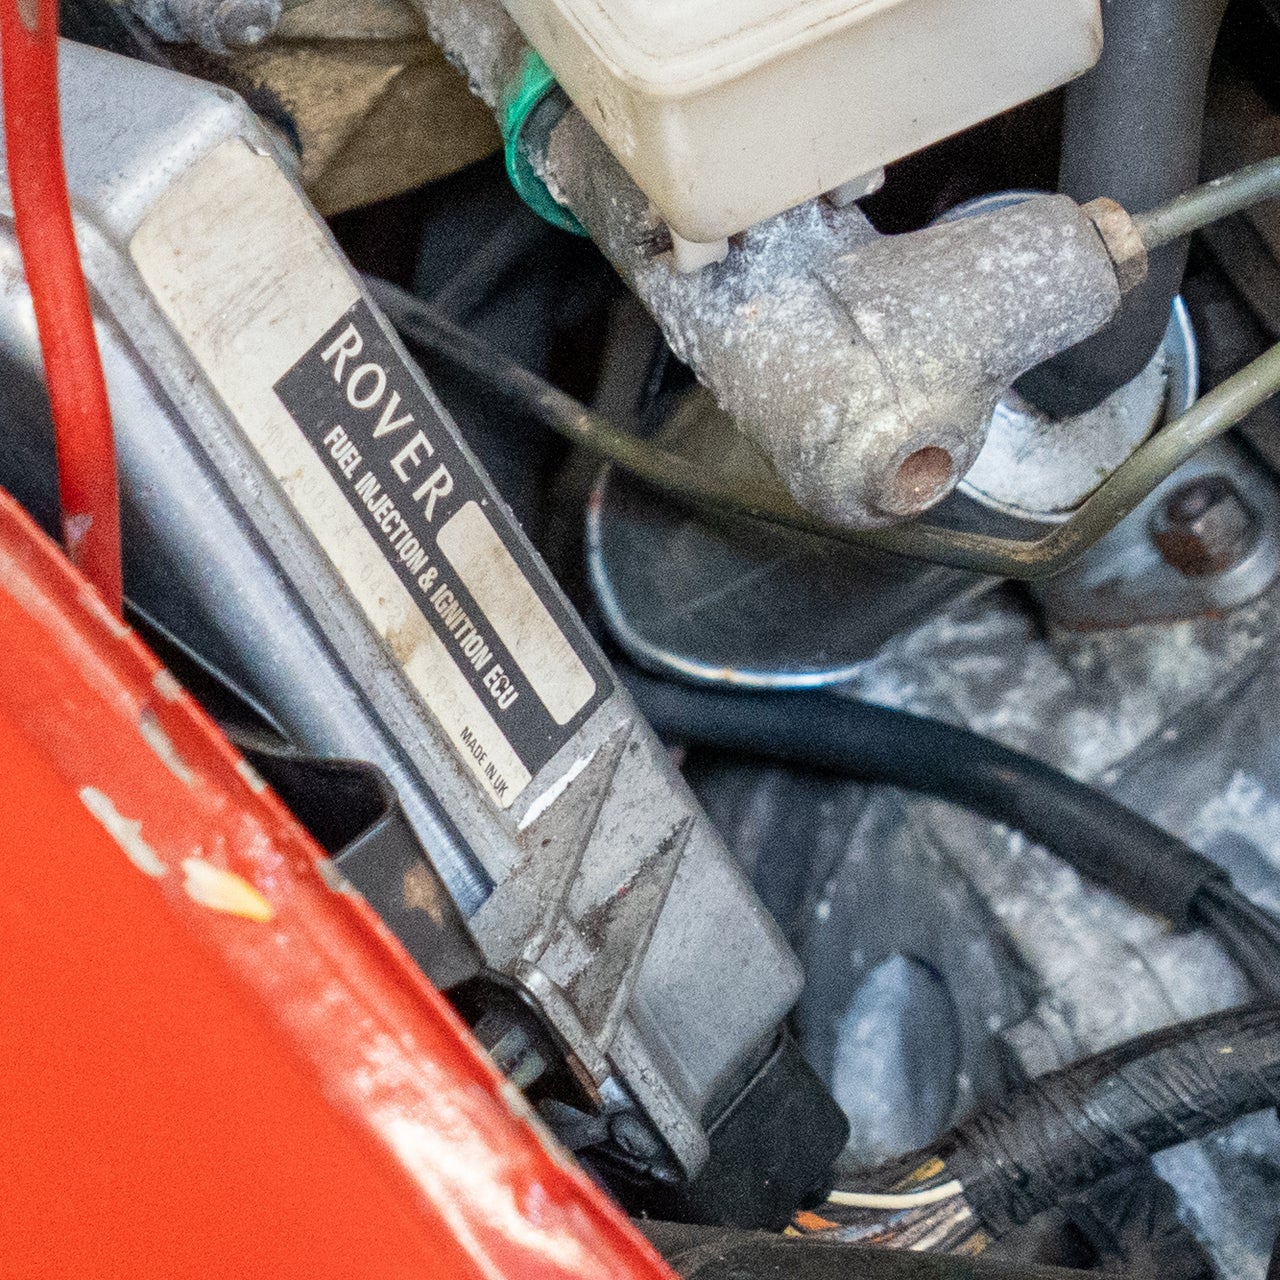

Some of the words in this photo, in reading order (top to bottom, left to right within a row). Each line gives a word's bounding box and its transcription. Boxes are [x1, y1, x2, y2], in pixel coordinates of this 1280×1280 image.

[321, 322, 453, 522] ROVER
[323, 425, 363, 479] FUEL
[354, 471, 430, 576] INJECTION
[418, 566, 439, 592] &
[429, 583, 493, 672] IGNITION
[483, 664, 519, 710] ECU
[459, 725, 487, 766] MADE
[484, 761, 497, 781] IN
[491, 773, 510, 799] UK
